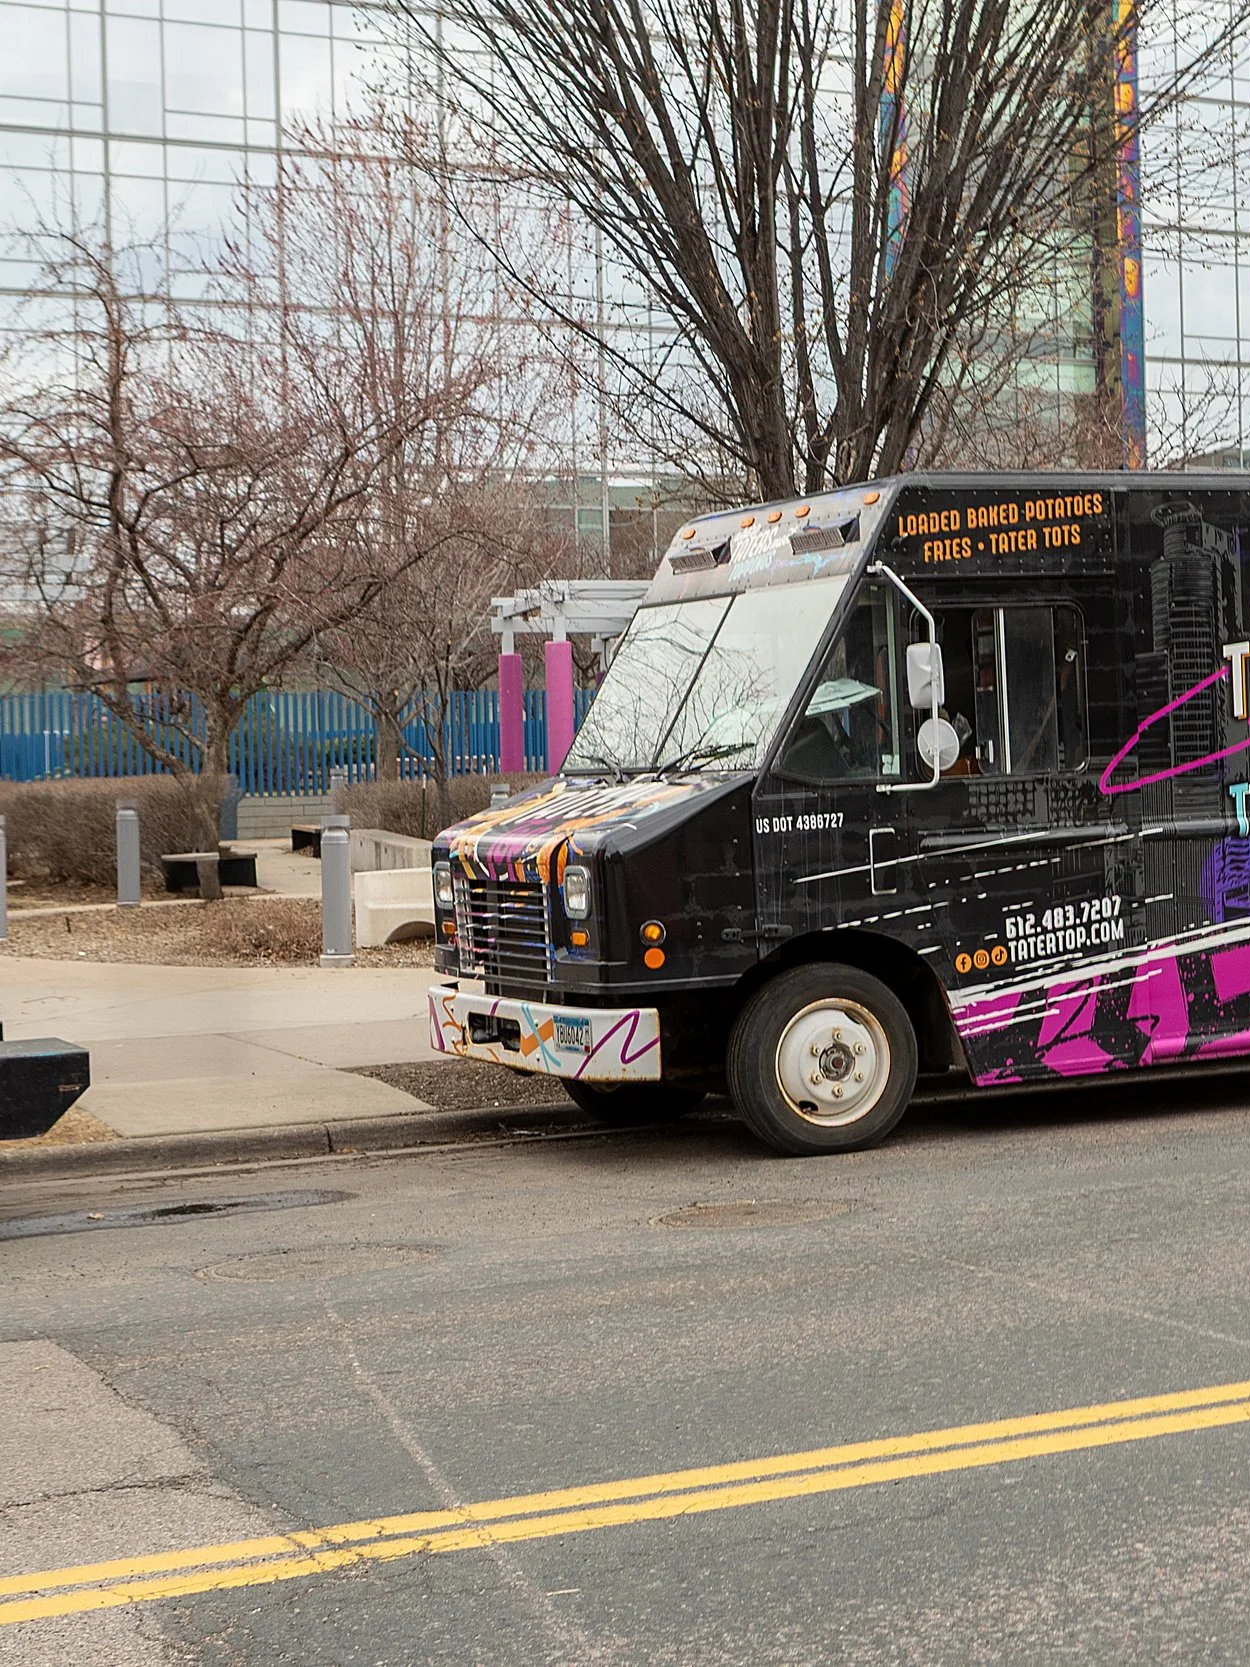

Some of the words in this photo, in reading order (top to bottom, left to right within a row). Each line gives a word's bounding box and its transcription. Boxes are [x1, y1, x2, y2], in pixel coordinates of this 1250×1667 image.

[899, 509, 961, 536] LOADED
[966, 503, 1019, 529] BAKED
[1025, 493, 1103, 522] POTATOES
[924, 537, 972, 563] FRIES
[989, 529, 1037, 555] TATER
[1042, 524, 1081, 548] TOTS
[755, 818, 770, 834] US
[772, 816, 793, 833] DOT
[796, 812, 844, 831] 4386727
[1005, 894, 1122, 939] 612.483.7207
[1008, 918, 1124, 962] TATERTOP.COM
